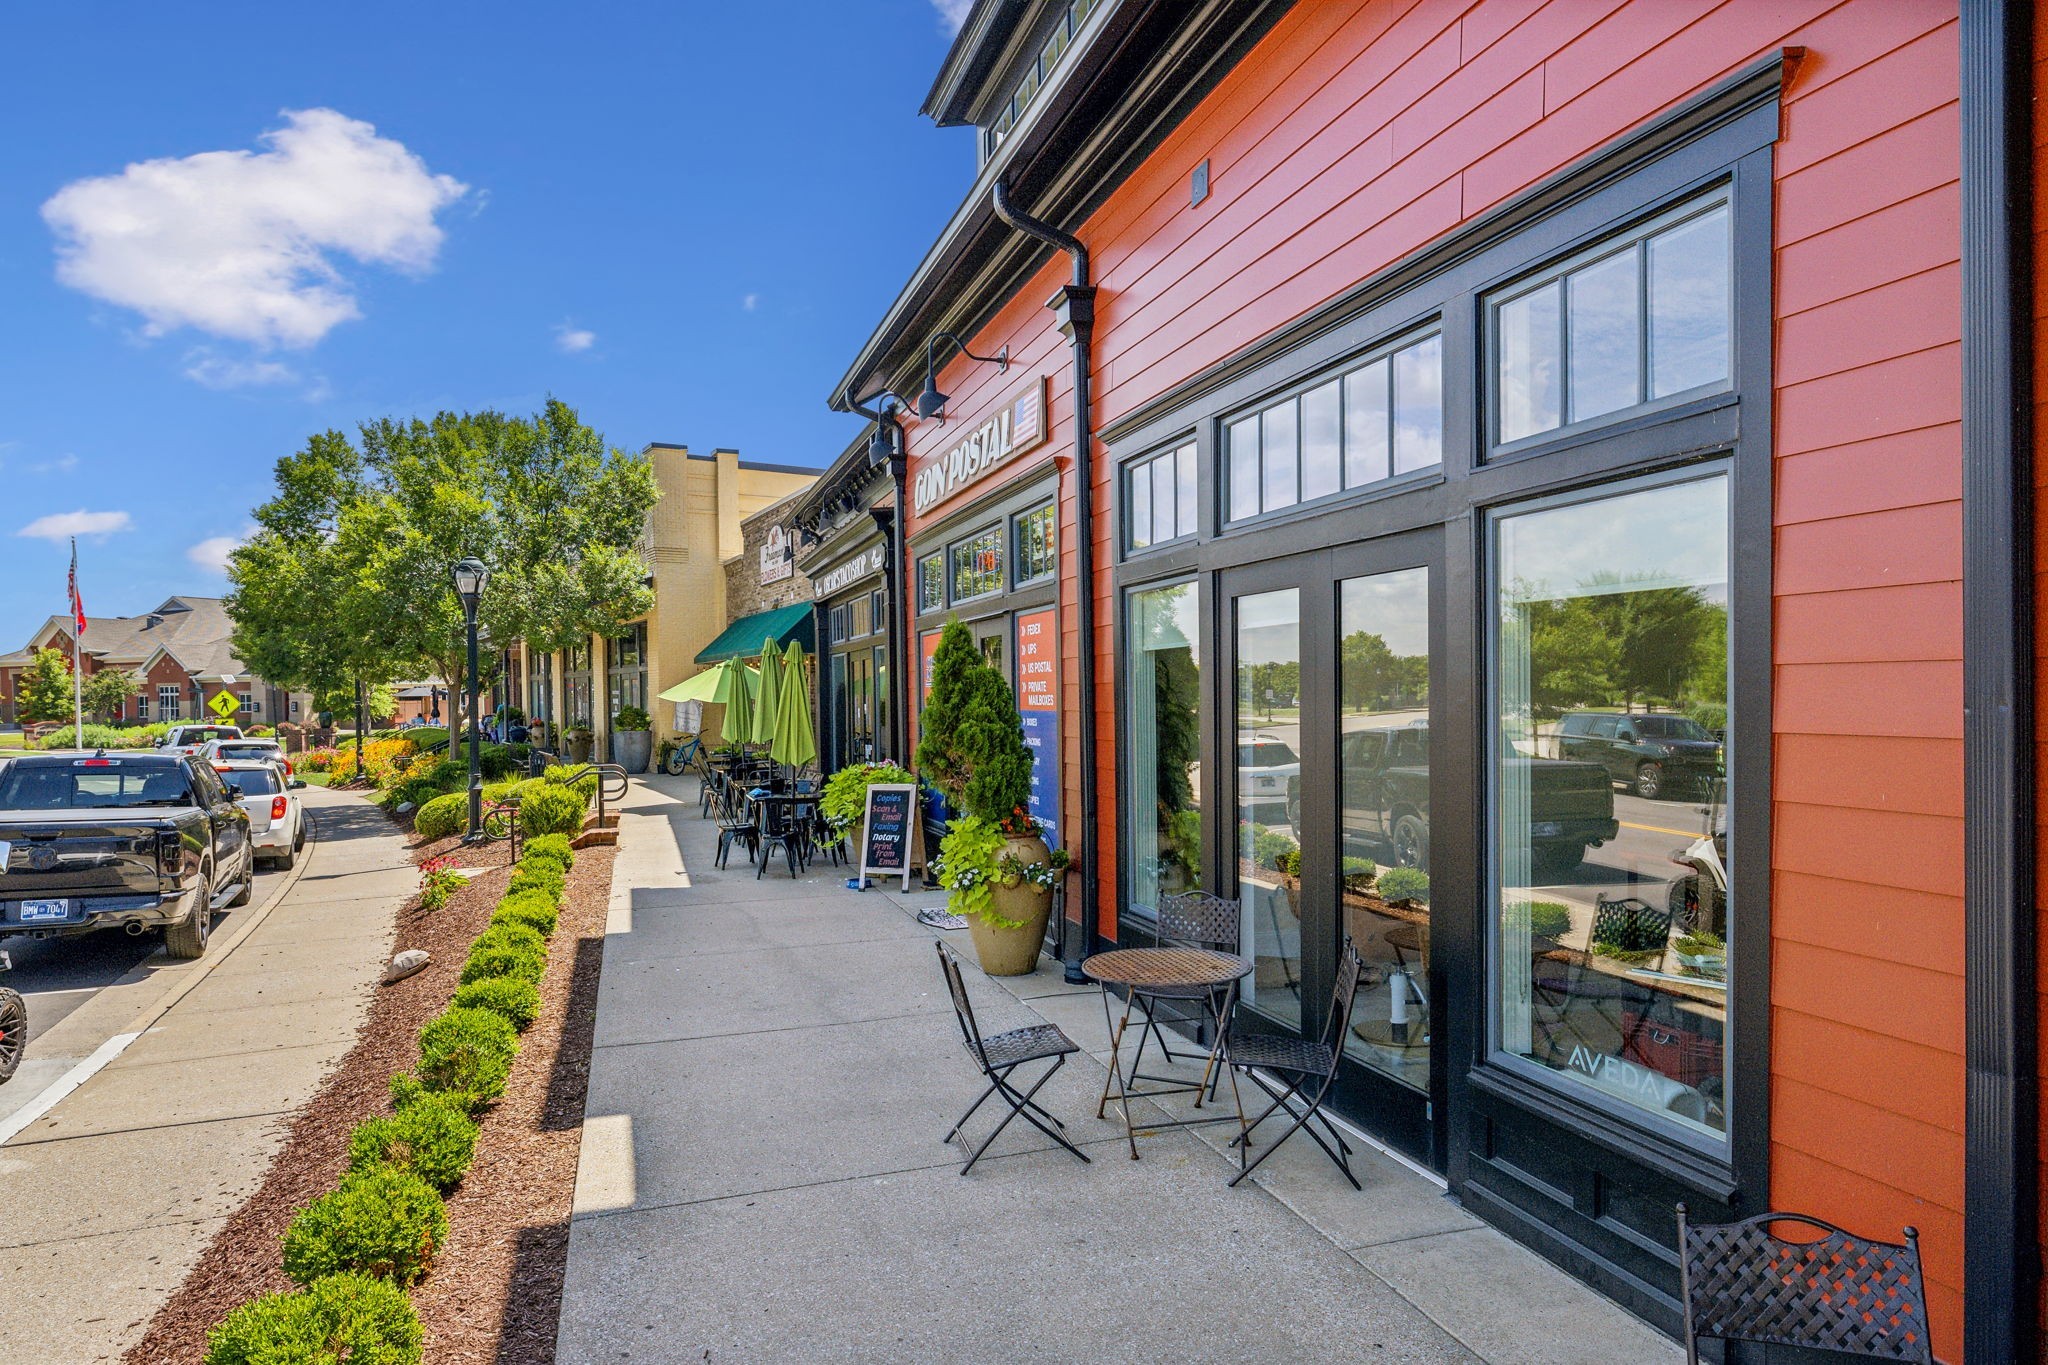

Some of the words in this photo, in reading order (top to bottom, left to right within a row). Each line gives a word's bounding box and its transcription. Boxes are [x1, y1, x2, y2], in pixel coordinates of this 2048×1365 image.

[948, 408, 1014, 490] POSTAL
[852, 555, 866, 579] SHOP
[1027, 623, 1041, 636] FEDEX
[1027, 643, 1037, 655] UPS
[1027, 662, 1034, 674] US
[1035, 661, 1052, 673] POSTAL
[1028, 681, 1047, 692] PRIVATE
[1028, 694, 1054, 706] MAILBOXES
[876, 793, 902, 804] Copies
[872, 805, 891, 813] Scan
[891, 805, 897, 813] &
[881, 812, 903, 821] Email
[872, 822, 899, 831] Faxing
[873, 842, 893, 850] Print
[878, 857, 900, 866] Email
[46, 903, 66, 914] 7047
[1567, 1043, 1662, 1102] AVEDA
